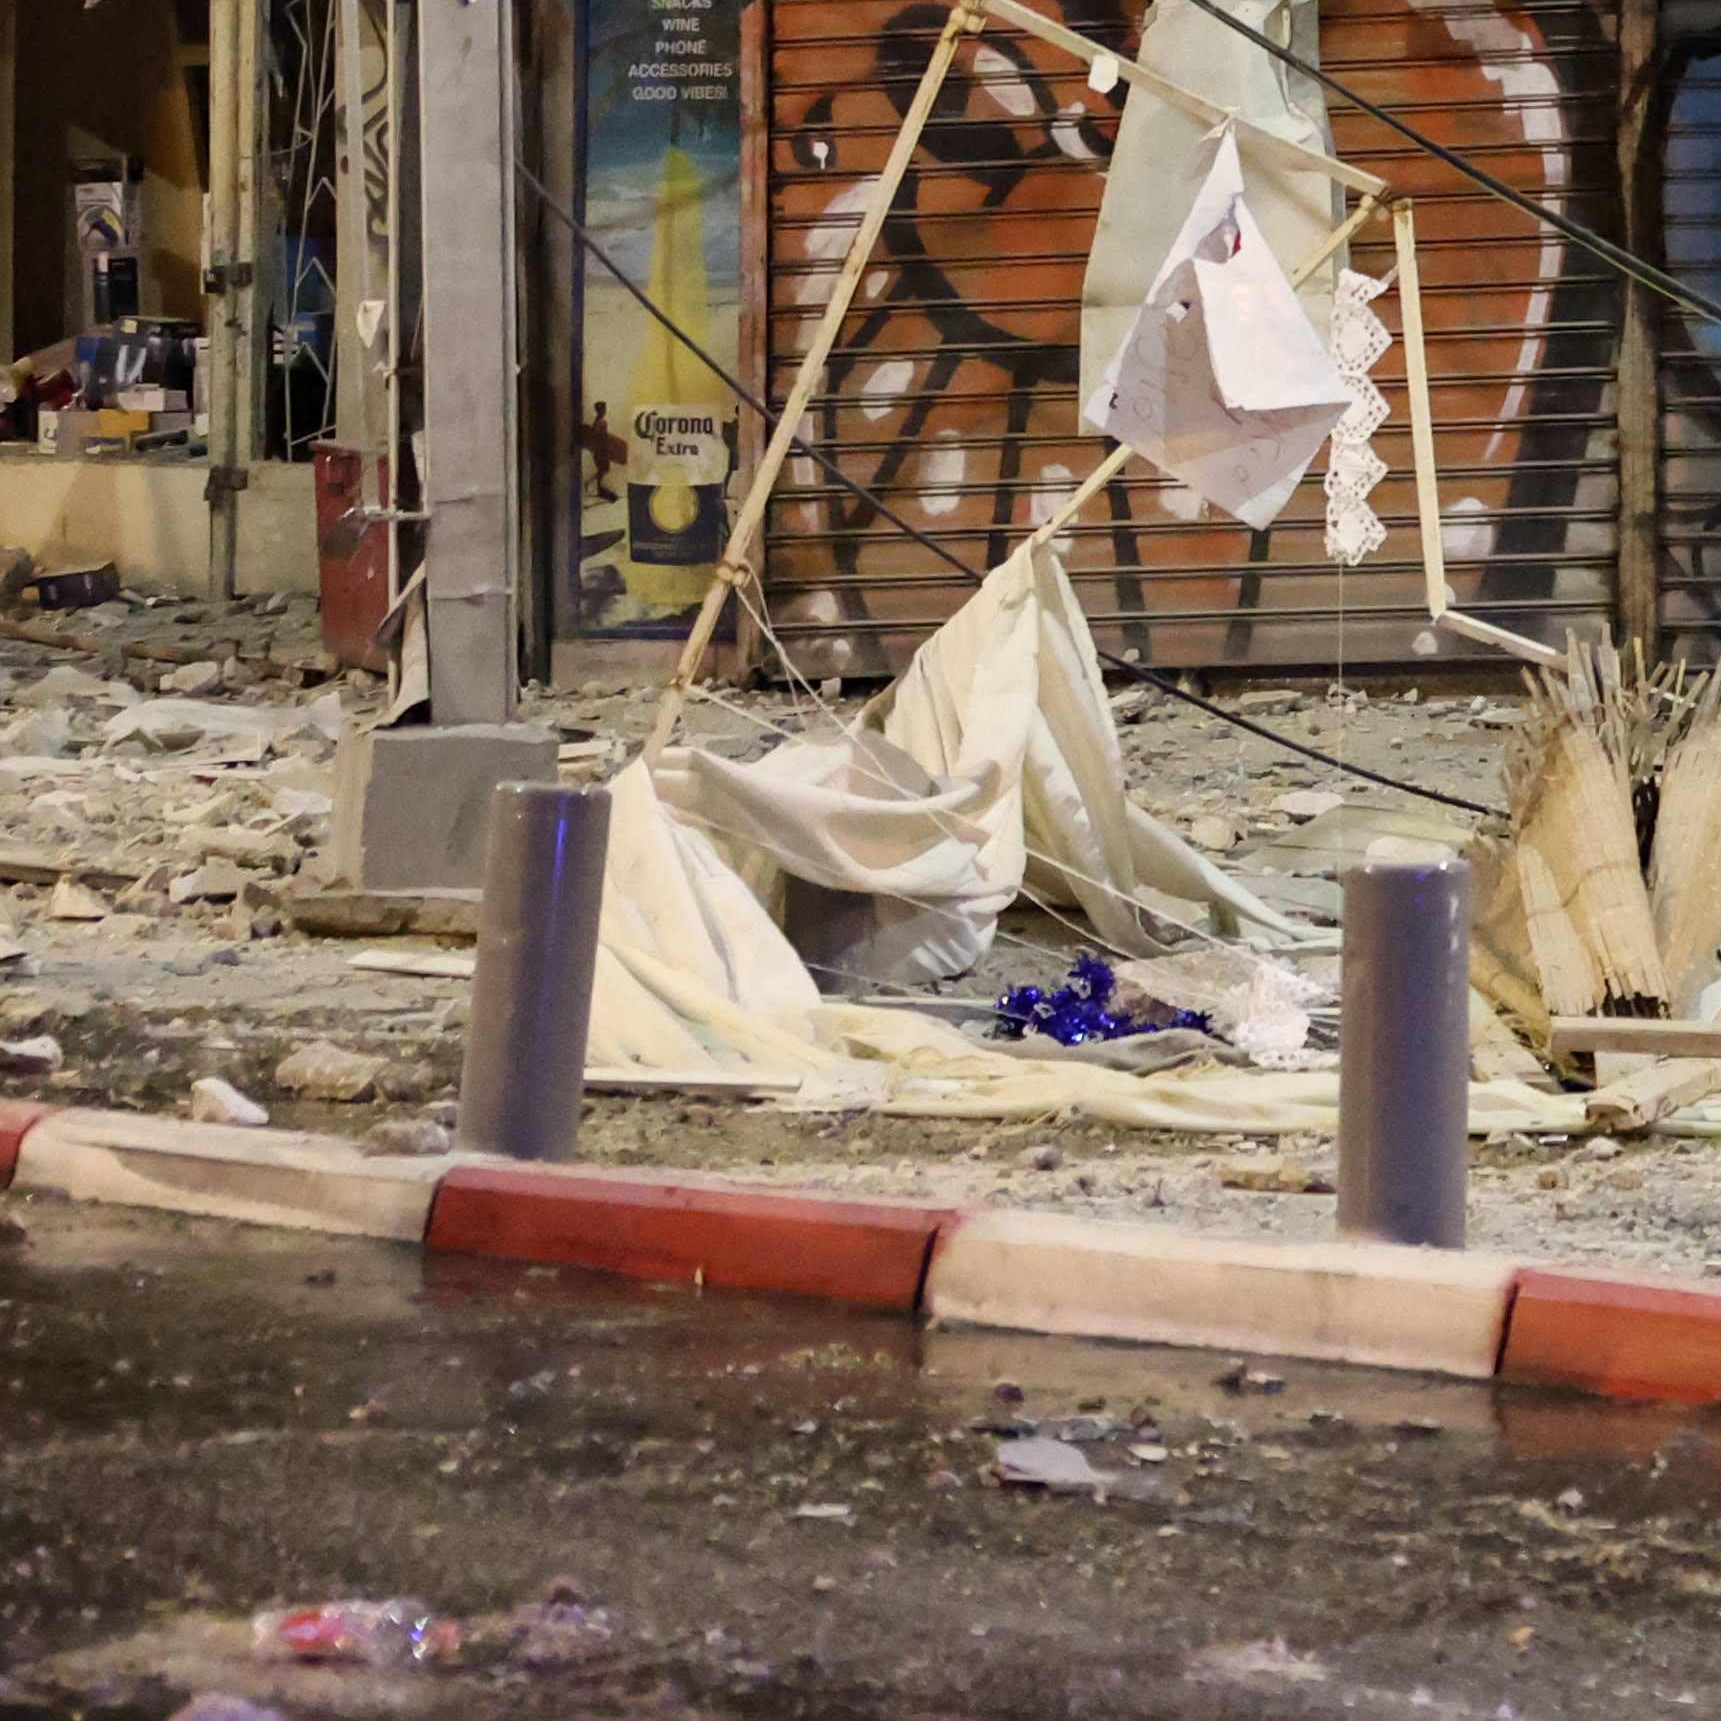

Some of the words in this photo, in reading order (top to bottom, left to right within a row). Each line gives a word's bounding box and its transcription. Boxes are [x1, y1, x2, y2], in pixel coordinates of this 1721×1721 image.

[661, 17, 701, 31] WINE
[655, 39, 707, 55] PHONE
[628, 62, 734, 78] ACCESSORIES
[632, 85, 678, 101] GOOD
[634, 409, 714, 441] Corona
[655, 437, 700, 456] Extra
